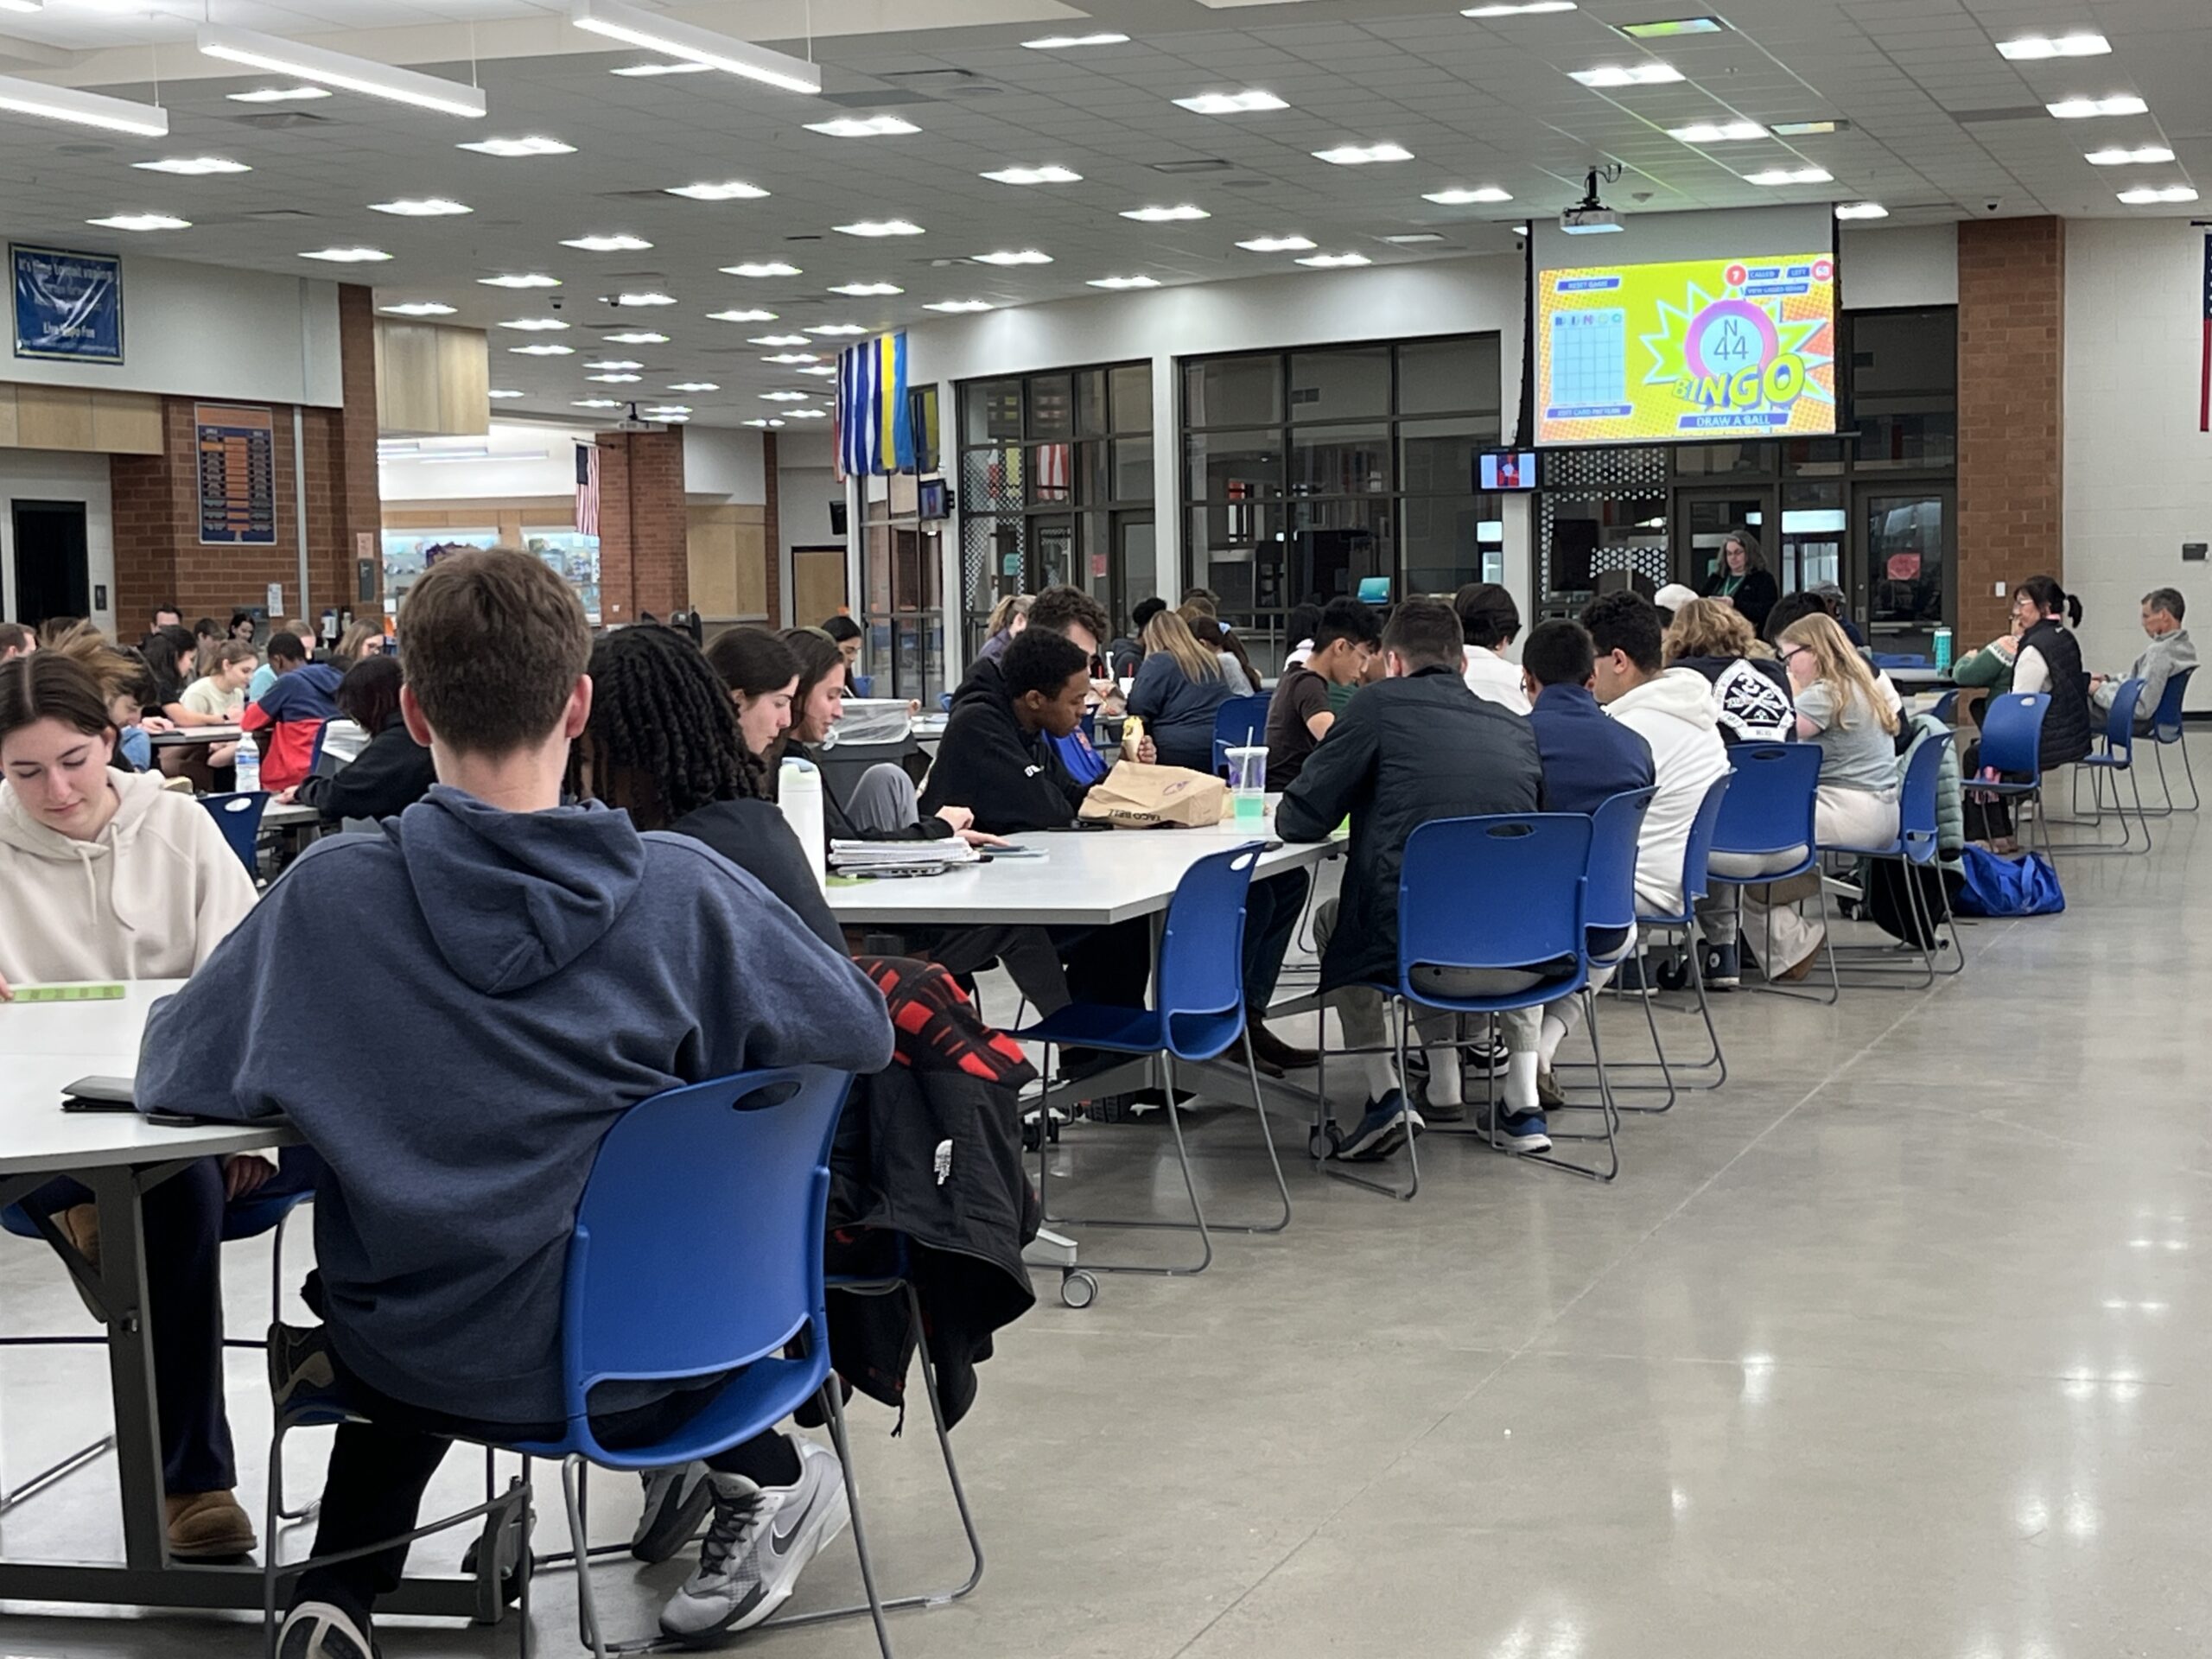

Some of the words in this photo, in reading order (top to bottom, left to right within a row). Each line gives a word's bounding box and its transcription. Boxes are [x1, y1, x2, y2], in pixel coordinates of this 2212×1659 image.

[1724, 319, 1738, 336] N
[1713, 335, 1749, 360] 44
[1672, 353, 1806, 409] BINGO
[1696, 416, 1730, 427] DRAW
[1733, 416, 1741, 426] A
[1742, 415, 1770, 425] BALL
[1108, 809, 1132, 818] BELL
[1133, 812, 1161, 821] TACO
